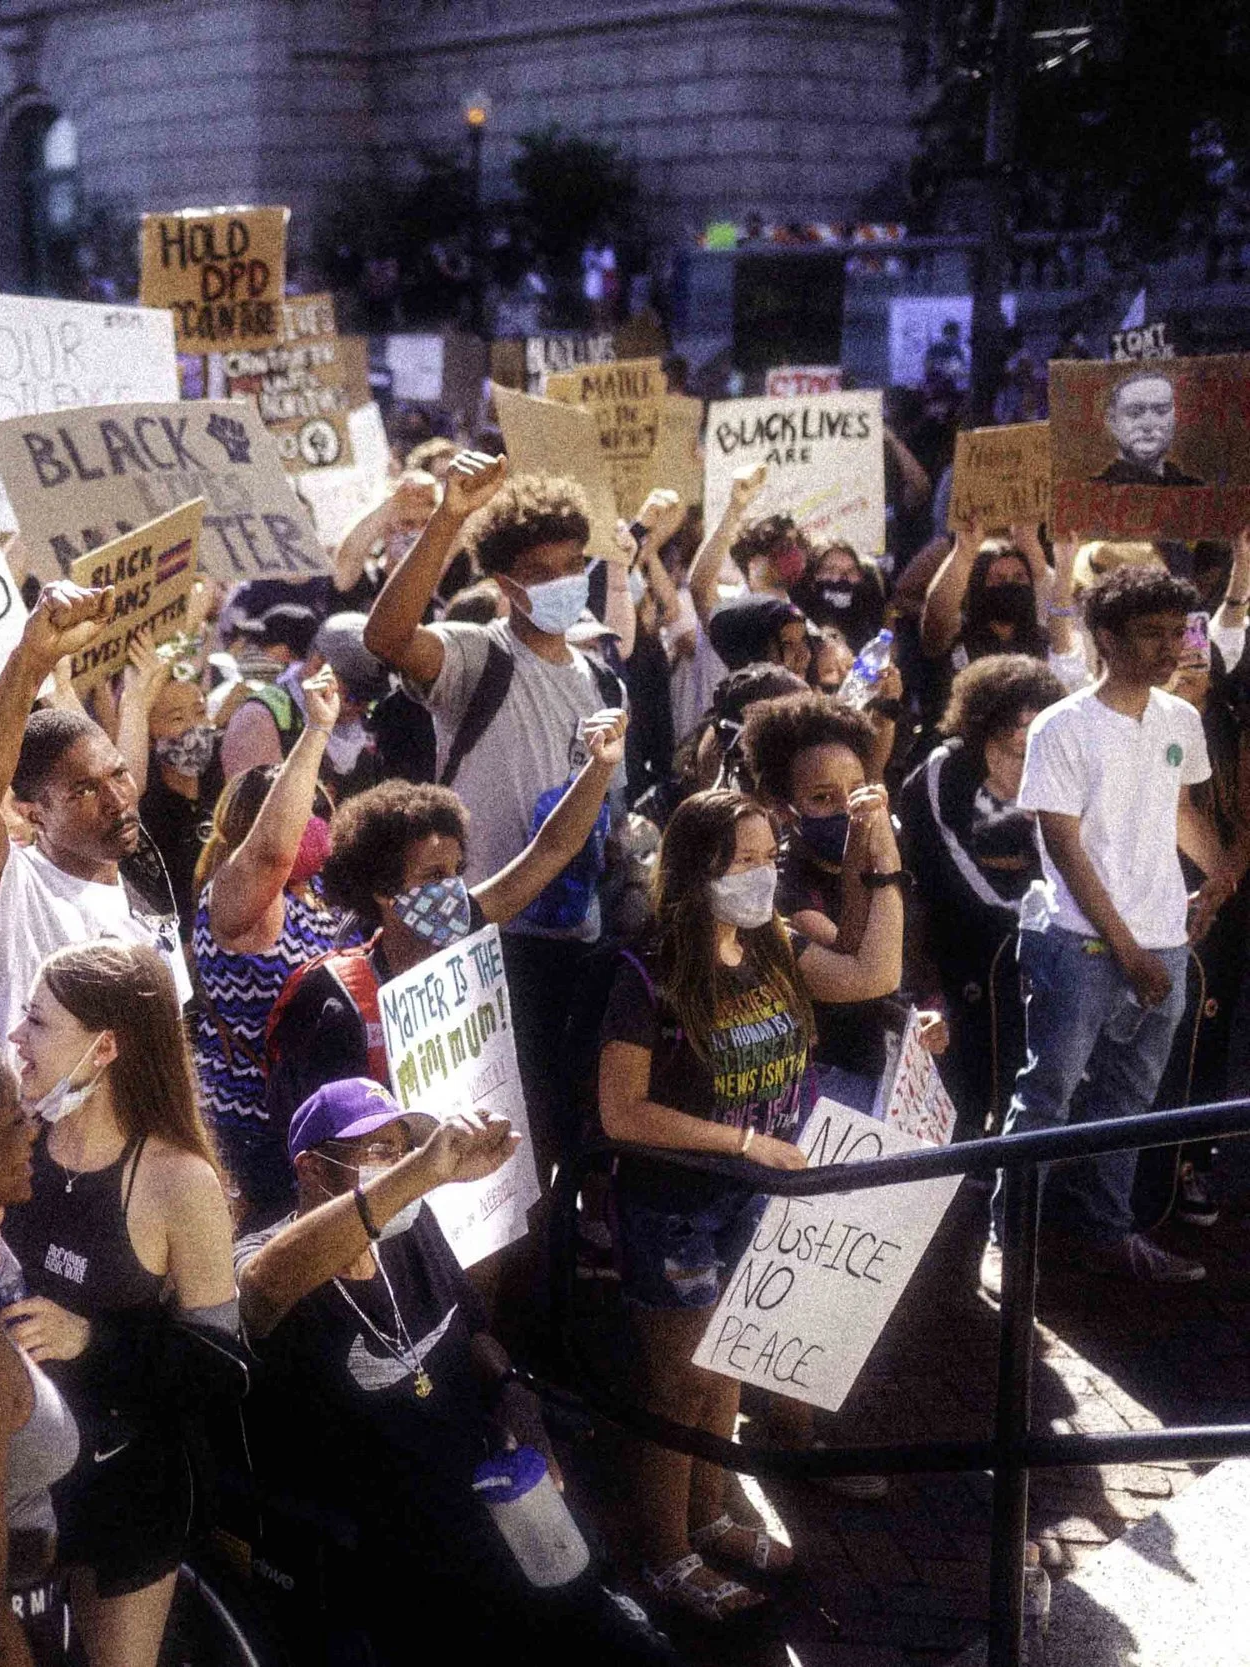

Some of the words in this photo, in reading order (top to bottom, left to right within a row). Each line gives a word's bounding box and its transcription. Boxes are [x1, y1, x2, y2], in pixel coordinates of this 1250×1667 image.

[159, 219, 250, 270] HOLD
[201, 258, 271, 303] DPD
[22, 414, 210, 489] BLACK
[715, 411, 797, 456] BLACK
[801, 407, 871, 441] LIVES
[763, 447, 812, 466] ARE
[445, 952, 468, 1007] IS
[467, 937, 503, 989] THE
[730, 1018, 775, 1049] HUMAN
[713, 1068, 759, 1098] NEWS
[726, 1258, 795, 1311] NO
[710, 1314, 825, 1389] PEACE
